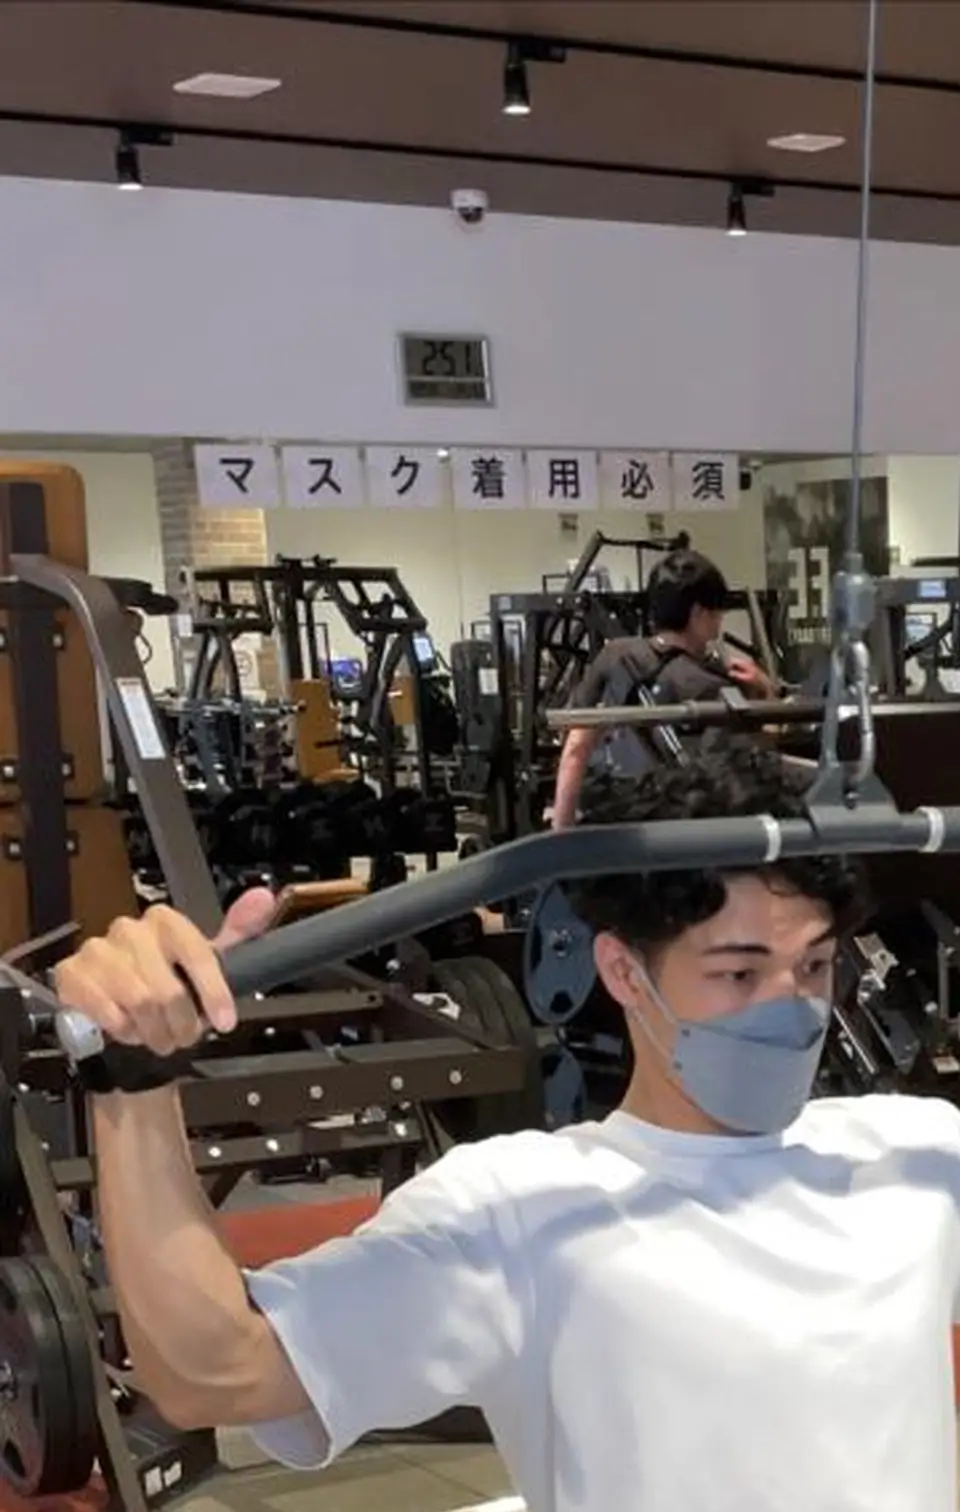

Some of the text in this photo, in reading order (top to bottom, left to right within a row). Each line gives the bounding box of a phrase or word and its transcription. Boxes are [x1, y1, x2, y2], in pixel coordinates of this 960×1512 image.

[219, 455, 726, 500] マスク着用必須
